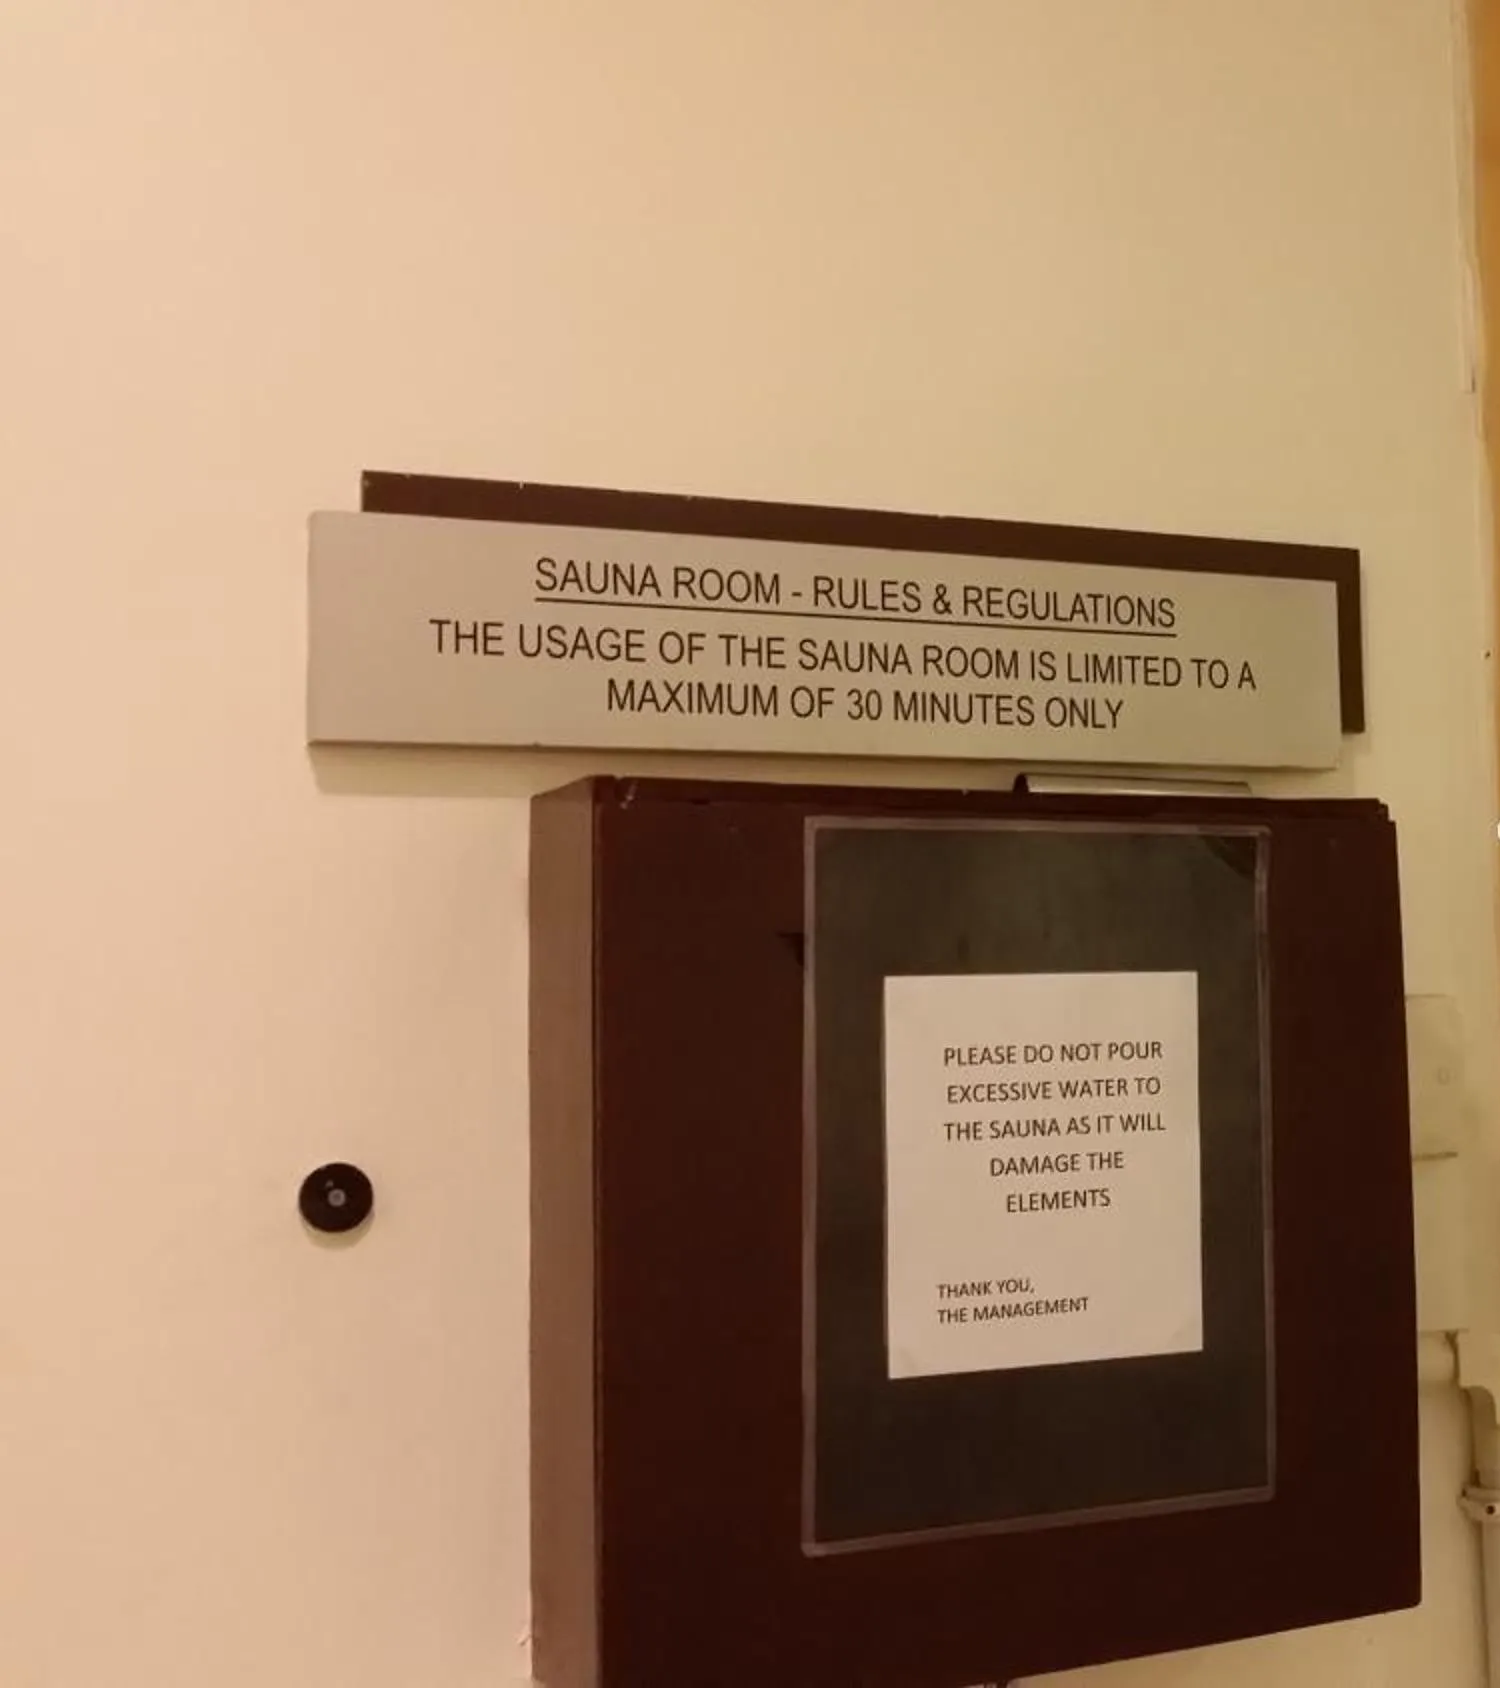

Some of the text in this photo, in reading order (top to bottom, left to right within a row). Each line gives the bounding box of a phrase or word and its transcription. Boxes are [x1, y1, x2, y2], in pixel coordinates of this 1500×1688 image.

[534, 557, 661, 599] SAUNA
[672, 567, 782, 605] ROOM
[813, 575, 922, 614] RULES
[933, 583, 953, 616] &
[962, 586, 1176, 628] REGULATIONS
[428, 619, 1257, 690] THE USAGE OF THE SAUNA ROOM IS LIMITED TO A
[606, 678, 1124, 731] MAXIMUM OF 30 MINUTES ONLY
[943, 1041, 1163, 1067] PLEASE DO NOT POUR
[946, 1076, 1161, 1104] EXCESSIVE WATER TO
[943, 1112, 1166, 1142] THE SAUNA AS IT WILL
[990, 1151, 1124, 1177] DAMAGE THE
[1005, 1189, 1111, 1213] ELEMENTS
[936, 1278, 1035, 1300] THANK YOU,
[937, 1297, 1089, 1324] THE MANAGEMENT
